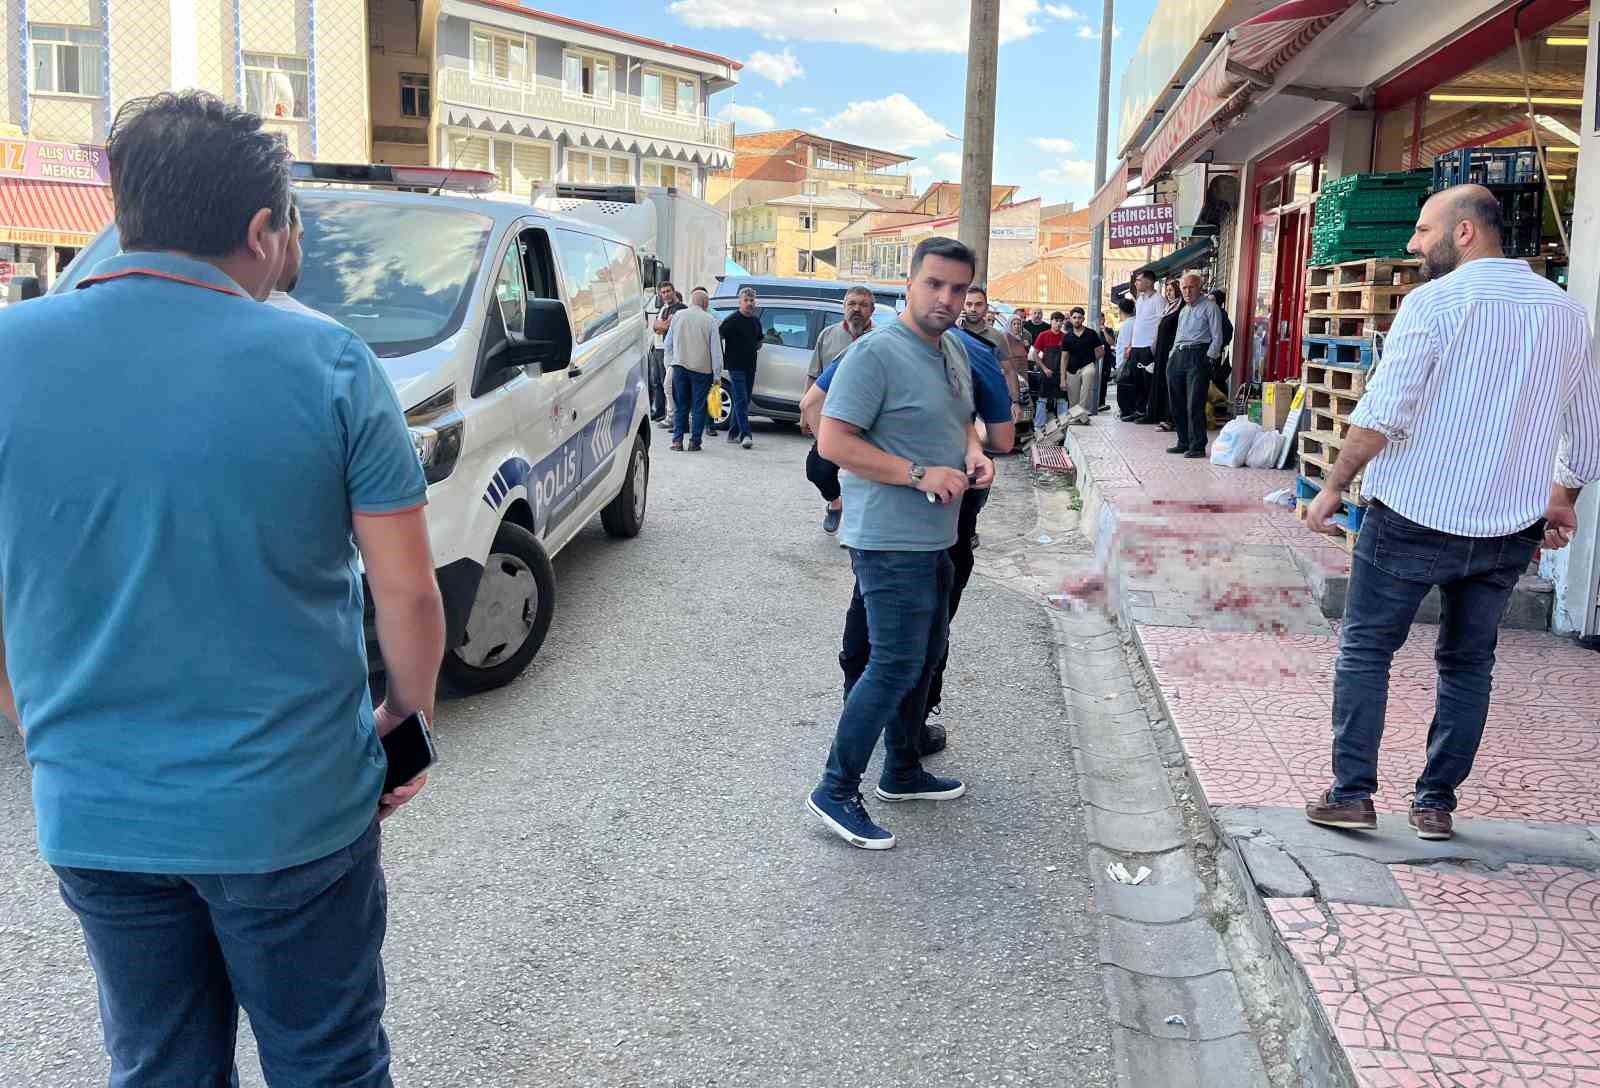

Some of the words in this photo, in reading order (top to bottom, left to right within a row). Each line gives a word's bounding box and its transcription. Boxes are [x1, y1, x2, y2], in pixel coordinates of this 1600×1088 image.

[41, 162, 95, 180] MERKEZİ
[1110, 205, 1173, 224] EKİNCİLER
[1110, 221, 1174, 239] ZÜCCACİYE
[534, 446, 577, 517] POLİS
